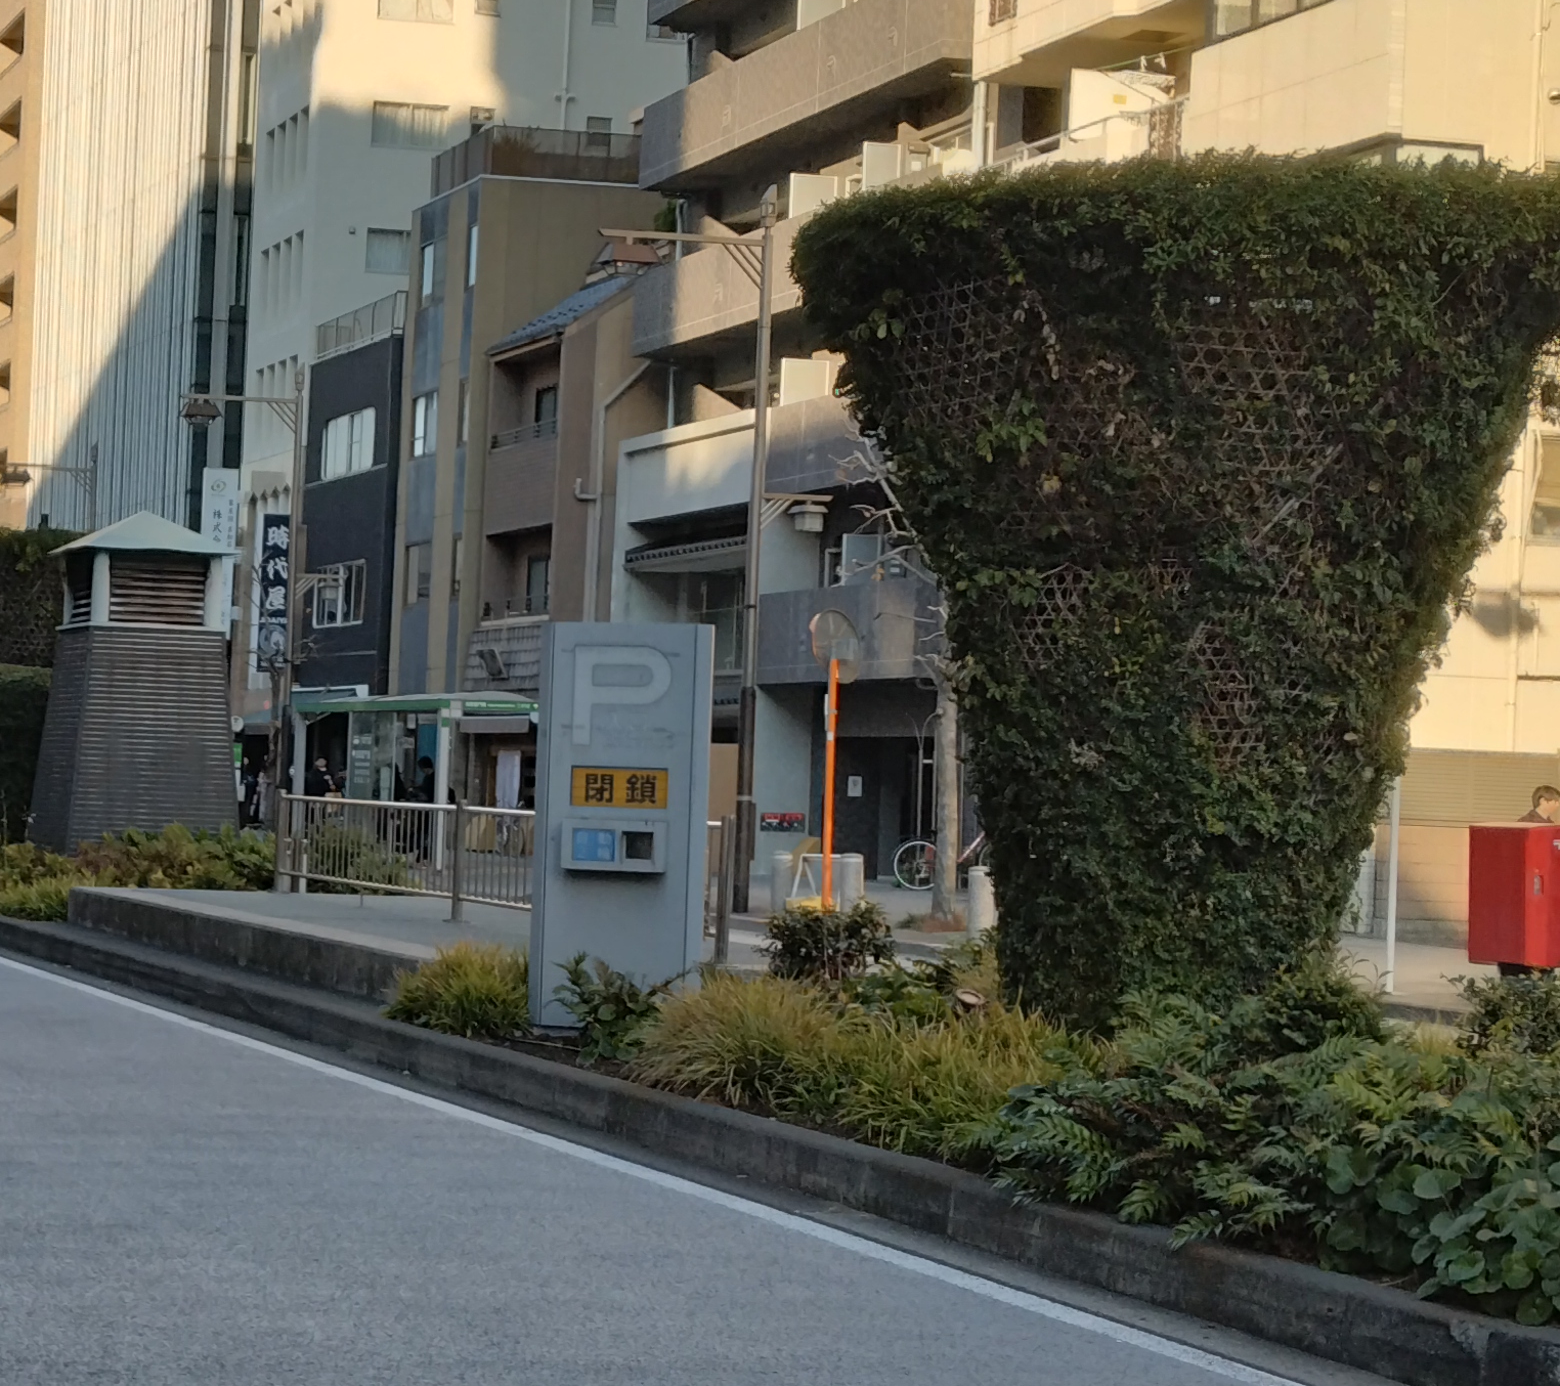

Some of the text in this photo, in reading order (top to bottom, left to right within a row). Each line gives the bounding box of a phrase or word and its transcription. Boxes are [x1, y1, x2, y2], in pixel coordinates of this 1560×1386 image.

[265, 524, 290, 610] 時代屋
[571, 644, 672, 746] P
[584, 773, 658, 805] 閉鎖
